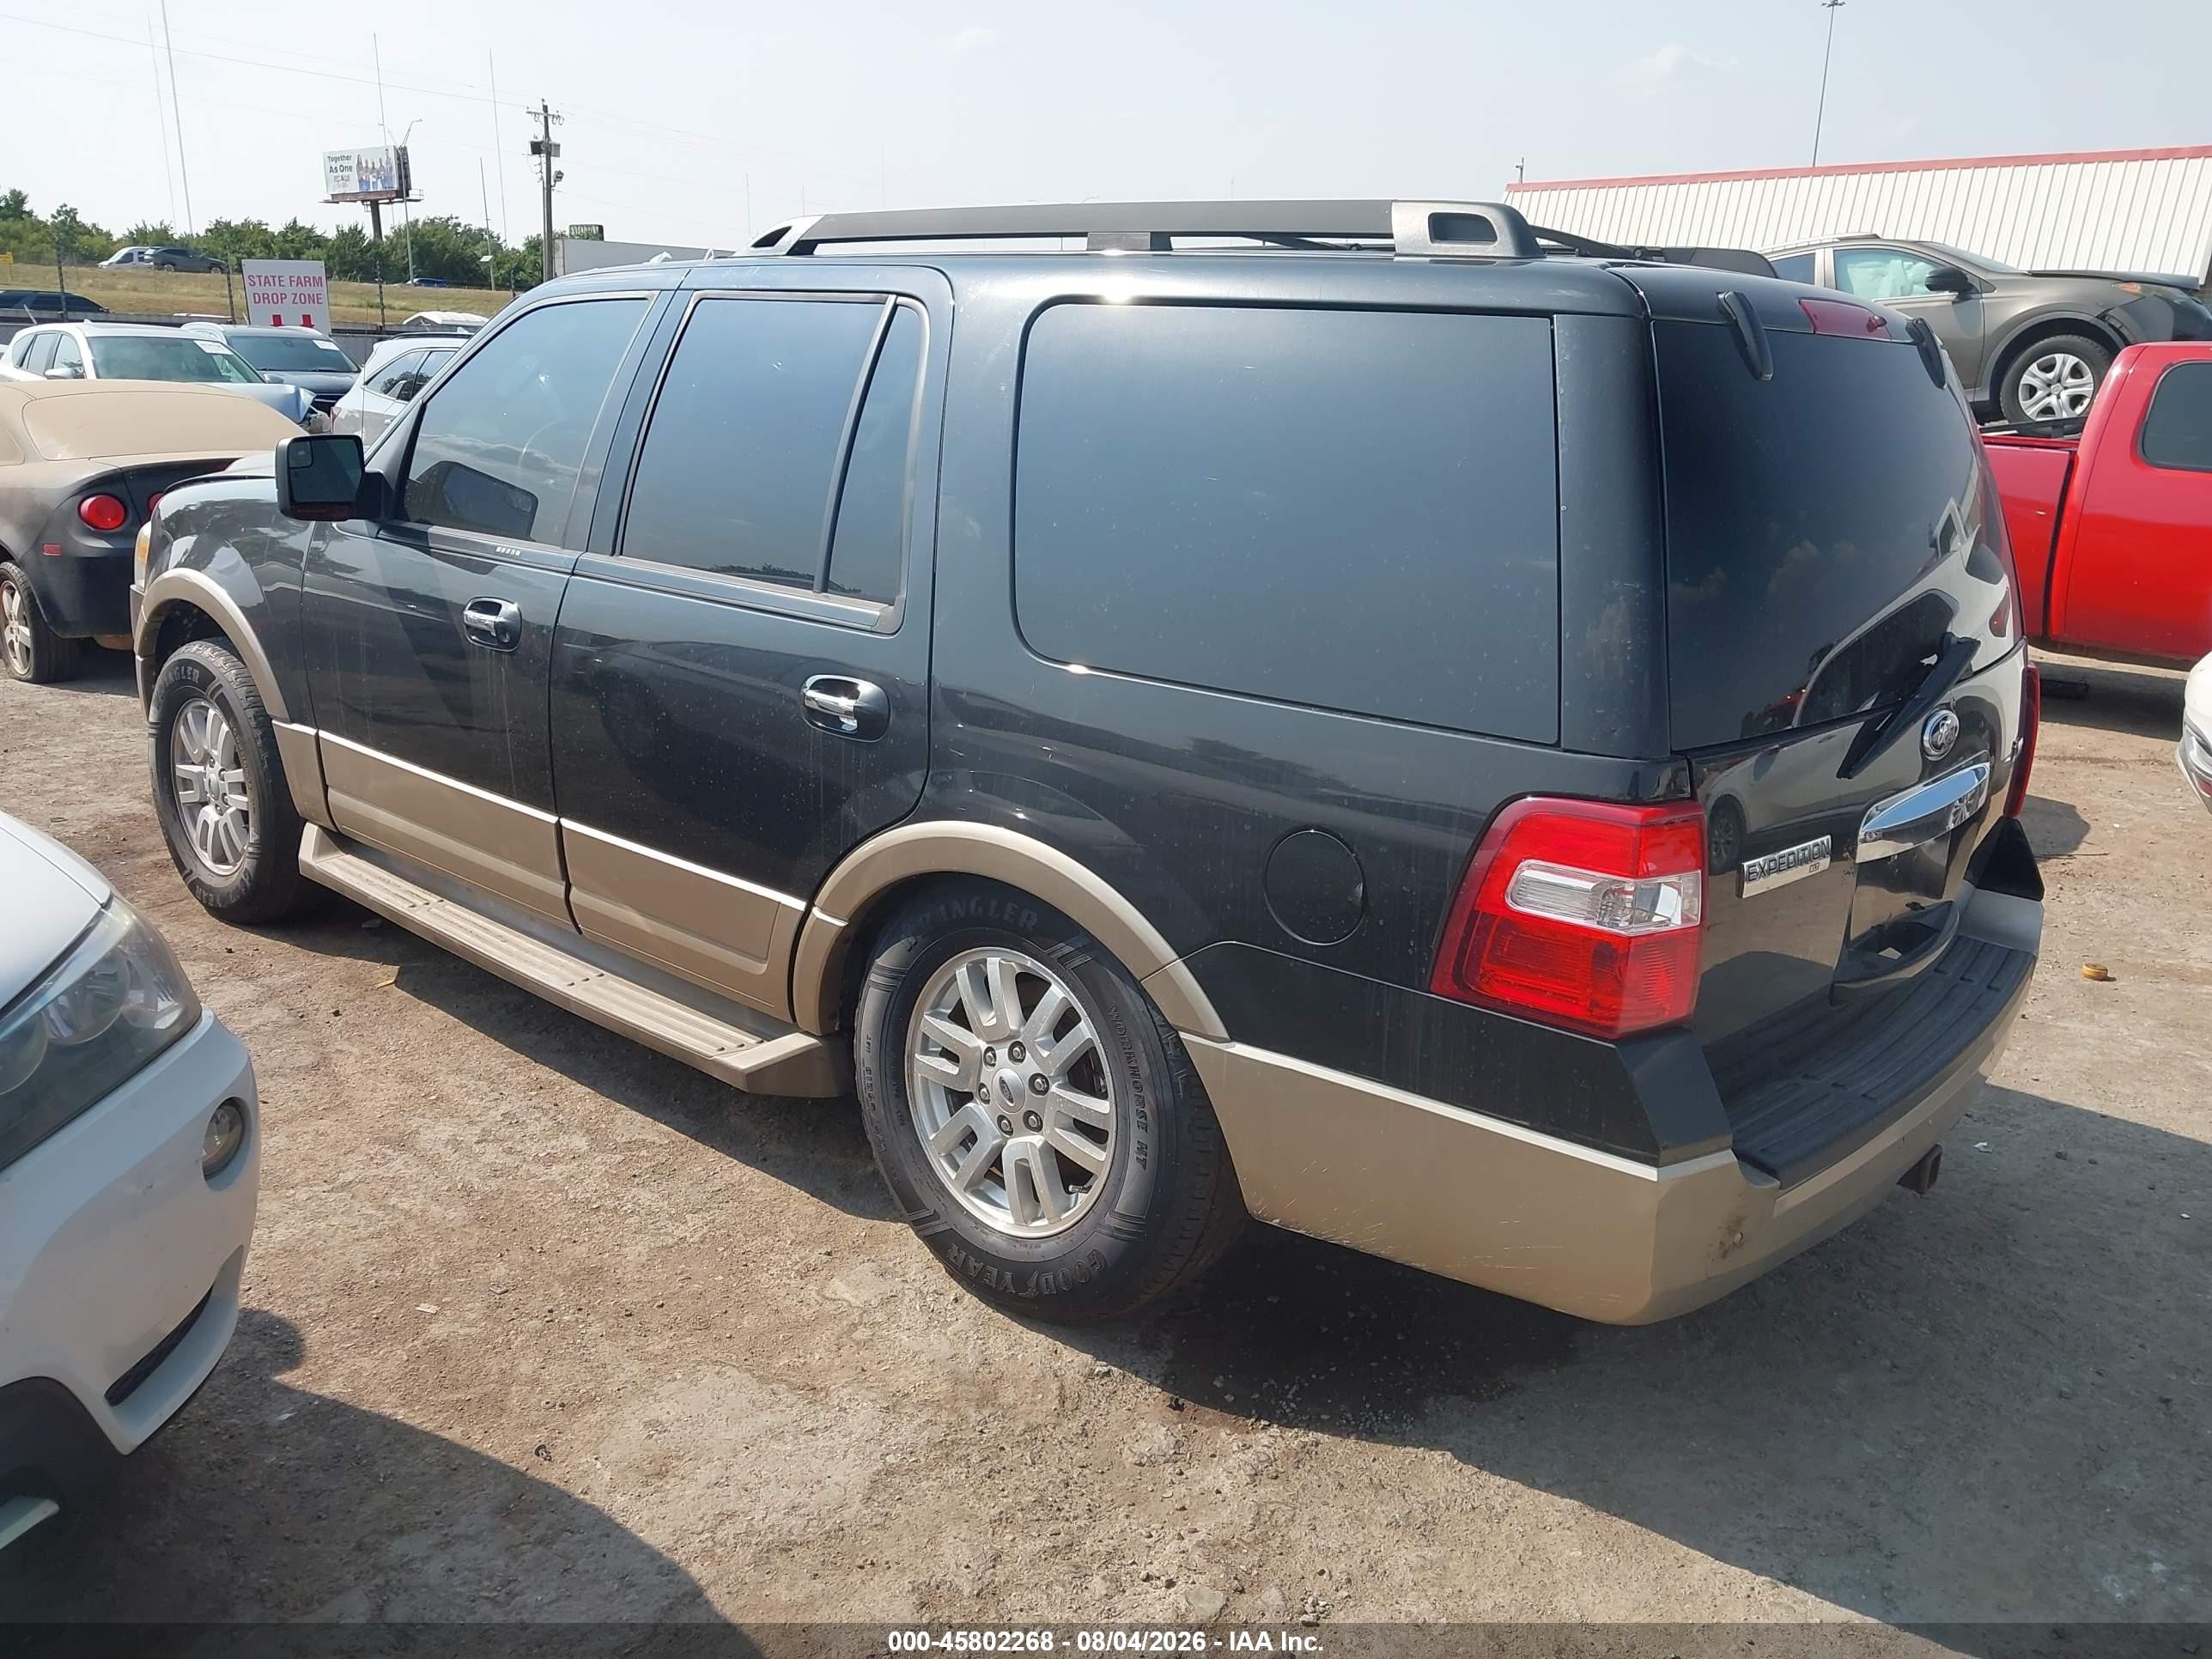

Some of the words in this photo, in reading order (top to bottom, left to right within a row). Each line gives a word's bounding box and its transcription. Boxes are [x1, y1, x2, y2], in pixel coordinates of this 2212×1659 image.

[327, 155, 352, 163] Together
[338, 164, 353, 173] One
[247, 274, 285, 287] STATE
[289, 276, 323, 288] FARM
[252, 292, 288, 305] DROP
[291, 293, 323, 305] ZONE
[1746, 838, 1830, 883] EXPEDITION
[1106, 1005, 1148, 1133] WORKHORSE
[1135, 1139, 1148, 1171] HT
